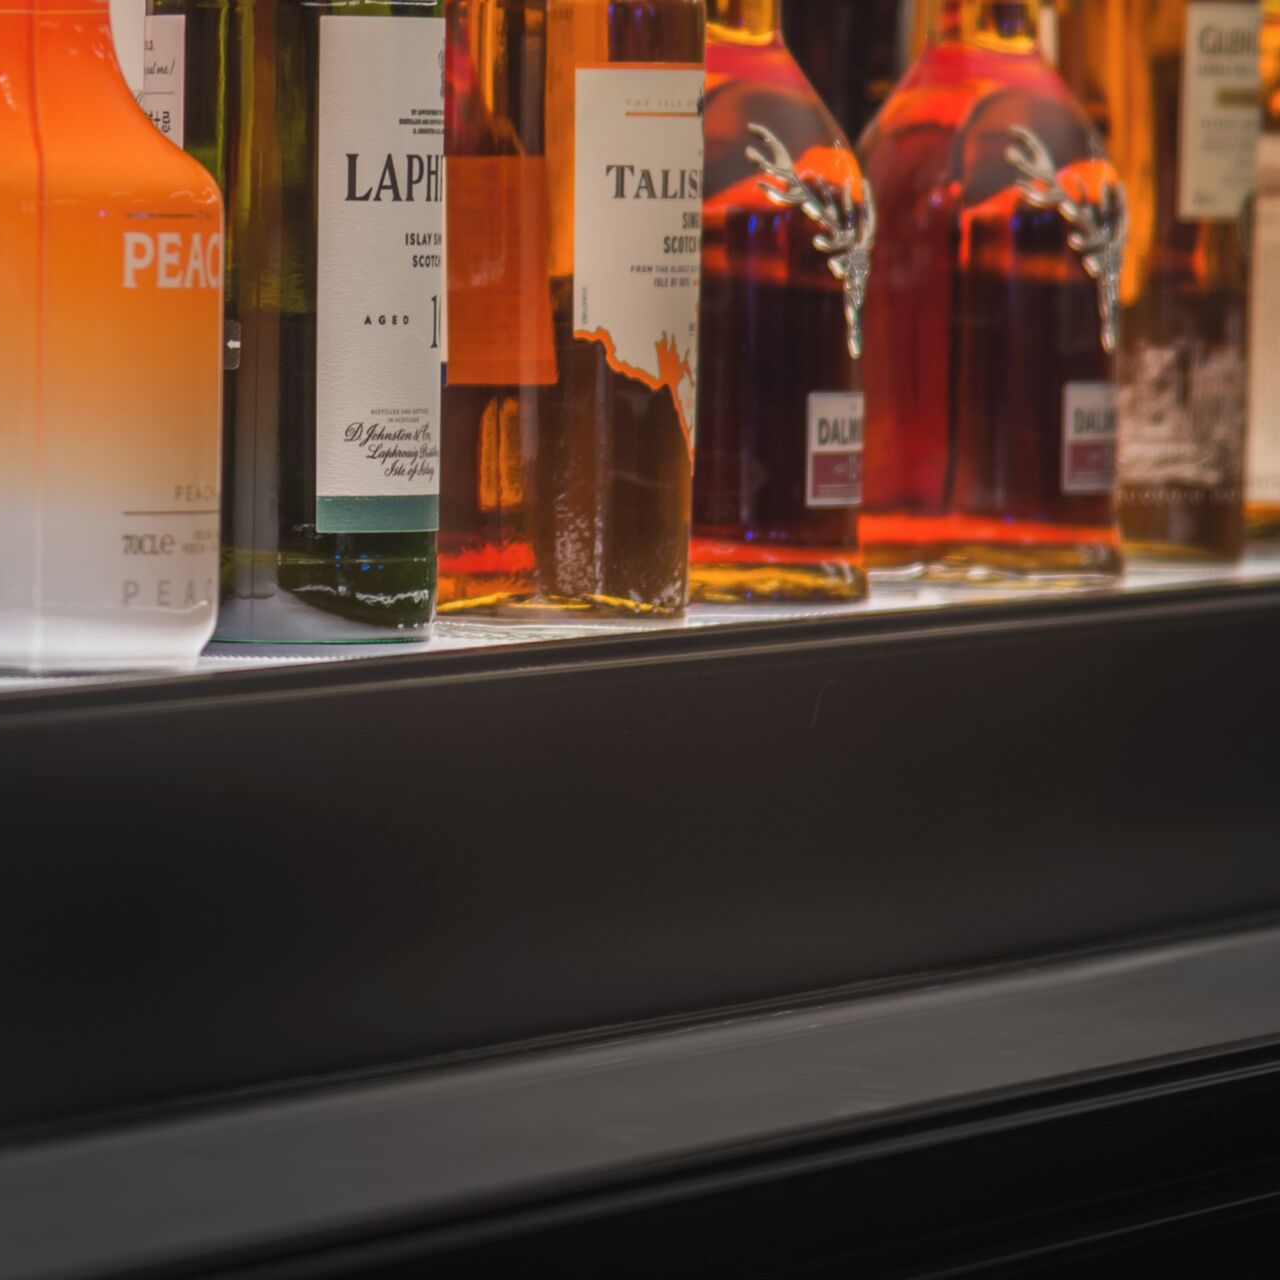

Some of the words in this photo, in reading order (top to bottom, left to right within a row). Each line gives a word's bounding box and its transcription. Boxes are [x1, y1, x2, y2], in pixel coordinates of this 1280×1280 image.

[344, 152, 444, 202] LAPH
[606, 164, 704, 199] TALIS
[405, 233, 432, 246] ISLAY
[630, 265, 653, 274] FROM
[363, 314, 410, 326] AGED
[430, 294, 442, 349] 1
[359, 423, 412, 448] Johnston
[365, 444, 419, 466] Laphroaig
[384, 458, 406, 477] Isle
